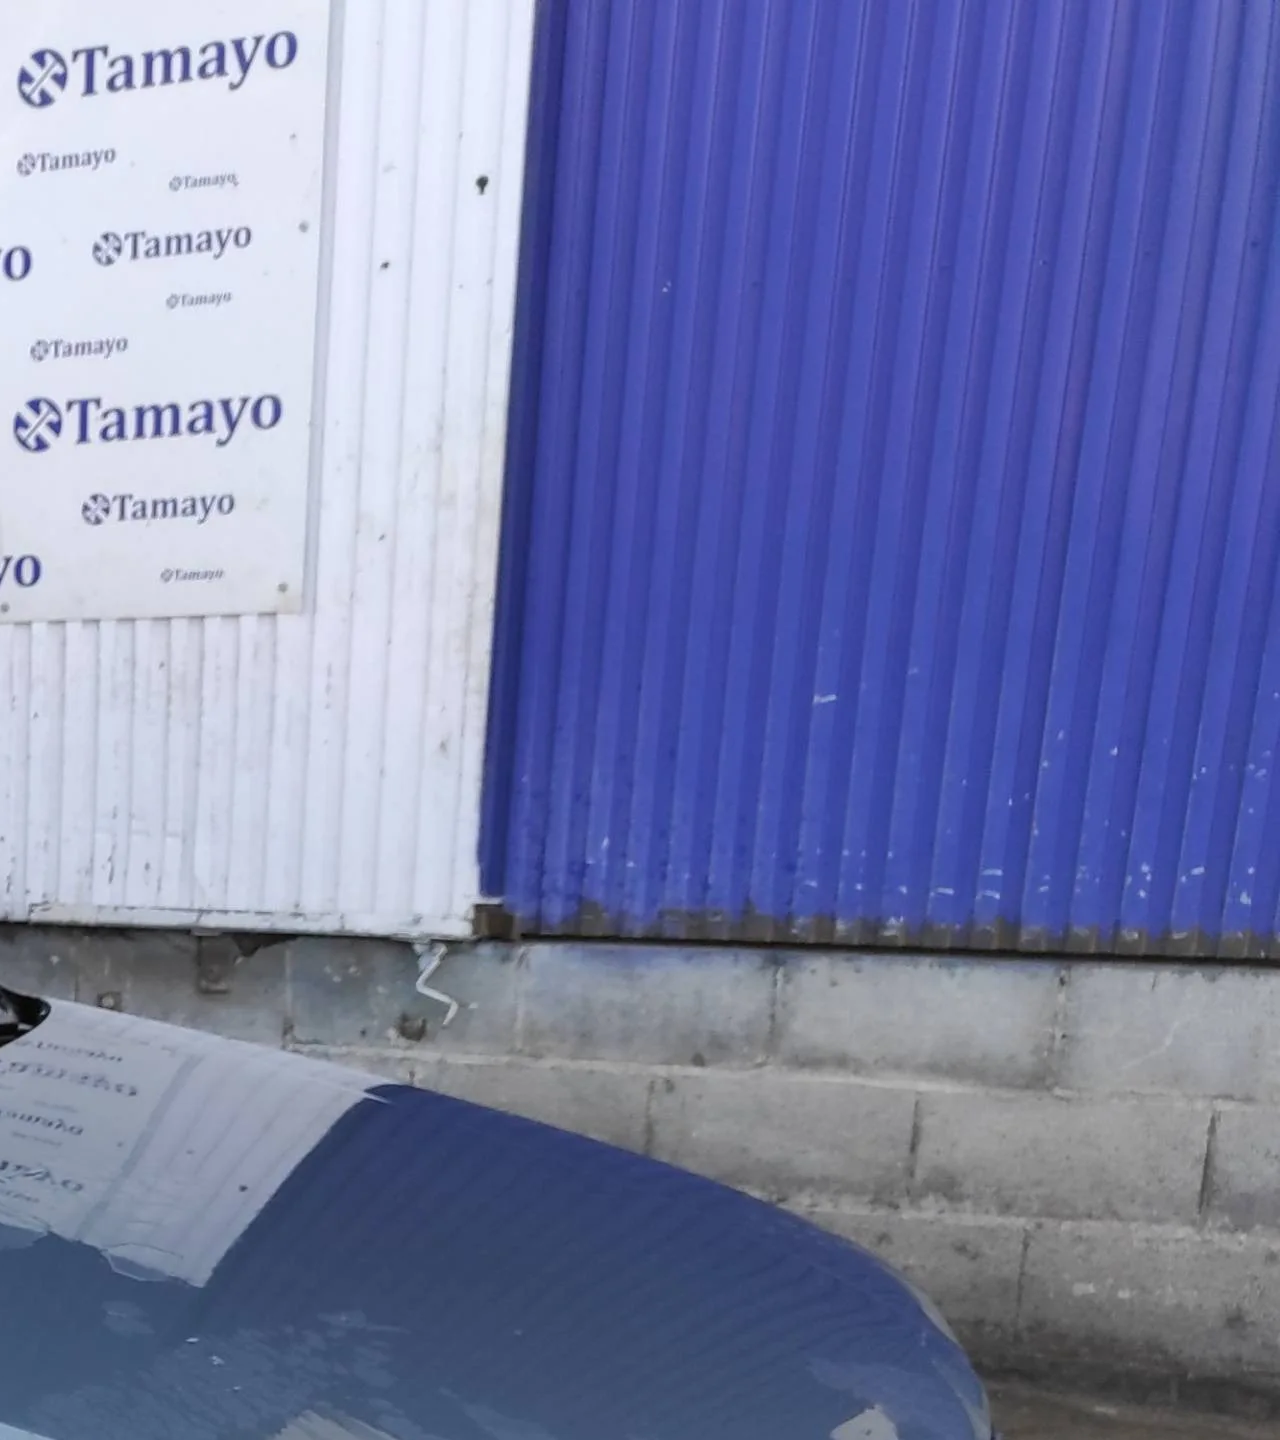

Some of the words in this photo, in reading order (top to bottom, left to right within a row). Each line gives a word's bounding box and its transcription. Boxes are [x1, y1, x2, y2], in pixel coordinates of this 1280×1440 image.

[72, 31, 297, 96] Tamayo
[35, 149, 116, 172] Tamayo
[124, 227, 251, 260] Tamayo
[49, 338, 128, 358] Tamayo
[66, 395, 282, 447] Tamayo
[112, 494, 235, 524] Tamayo
